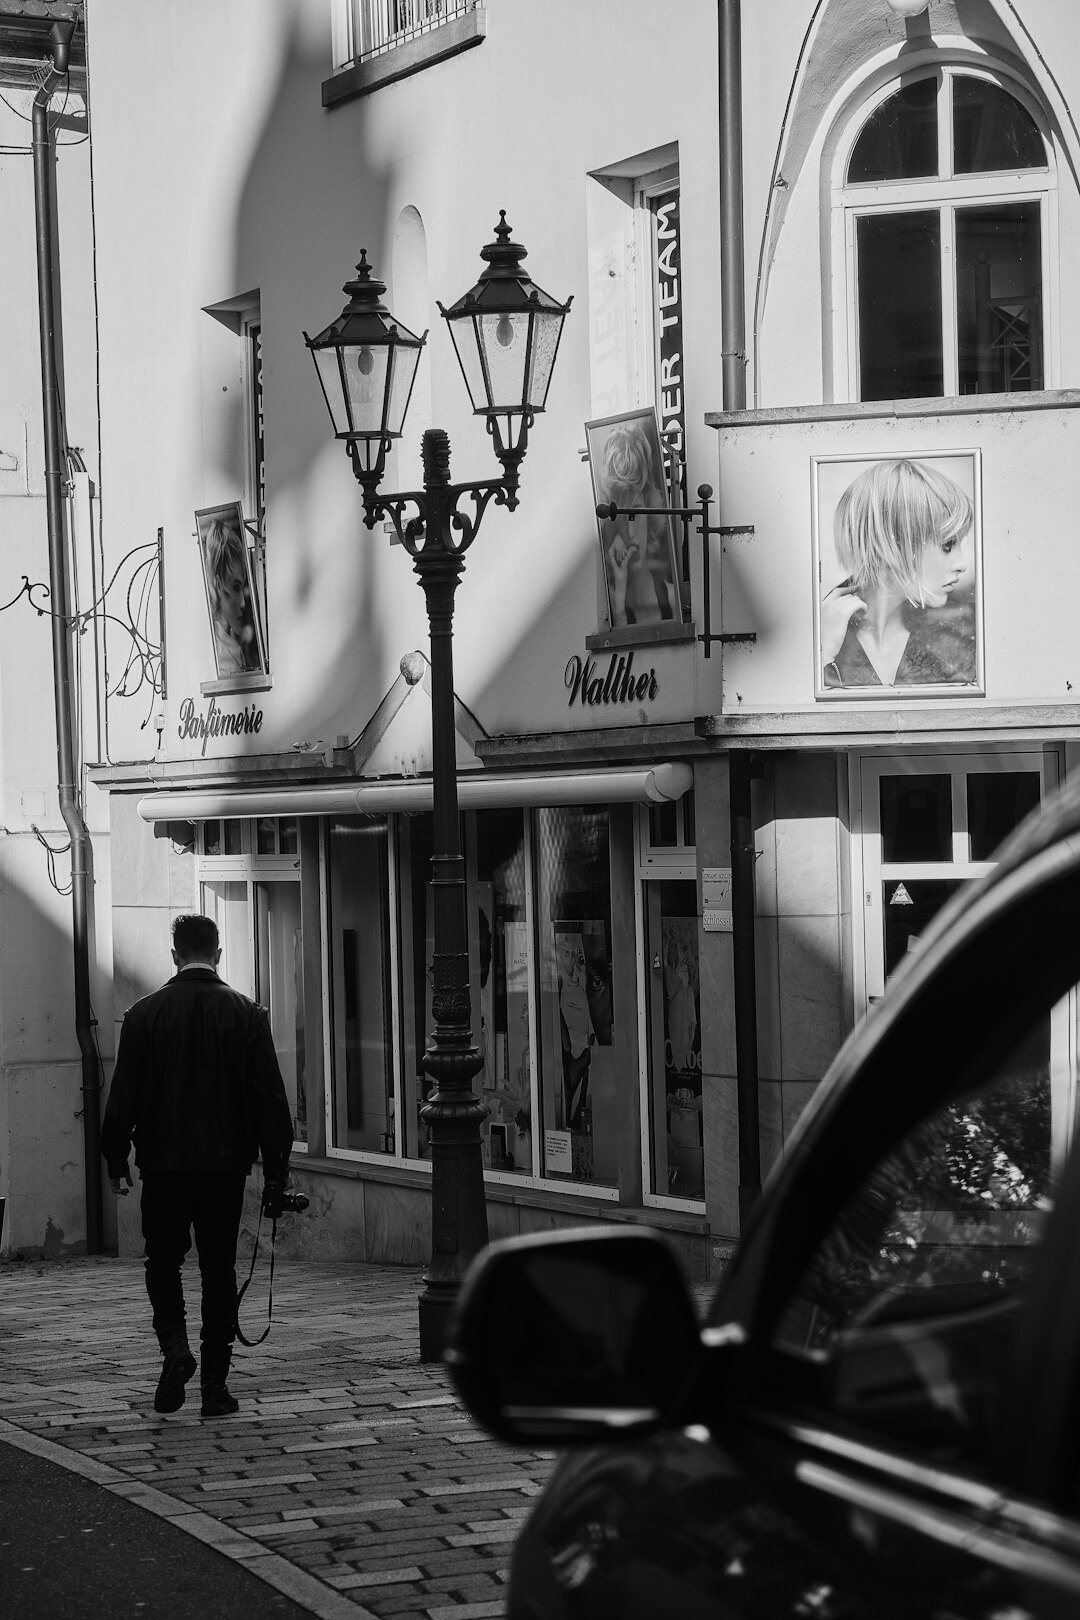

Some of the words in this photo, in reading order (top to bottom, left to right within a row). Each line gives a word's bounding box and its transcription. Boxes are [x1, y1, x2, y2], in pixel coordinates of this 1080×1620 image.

[657, 201, 679, 338] TEAM
[178, 697, 263, 756] Parfümerie
[564, 651, 659, 707] Walther
